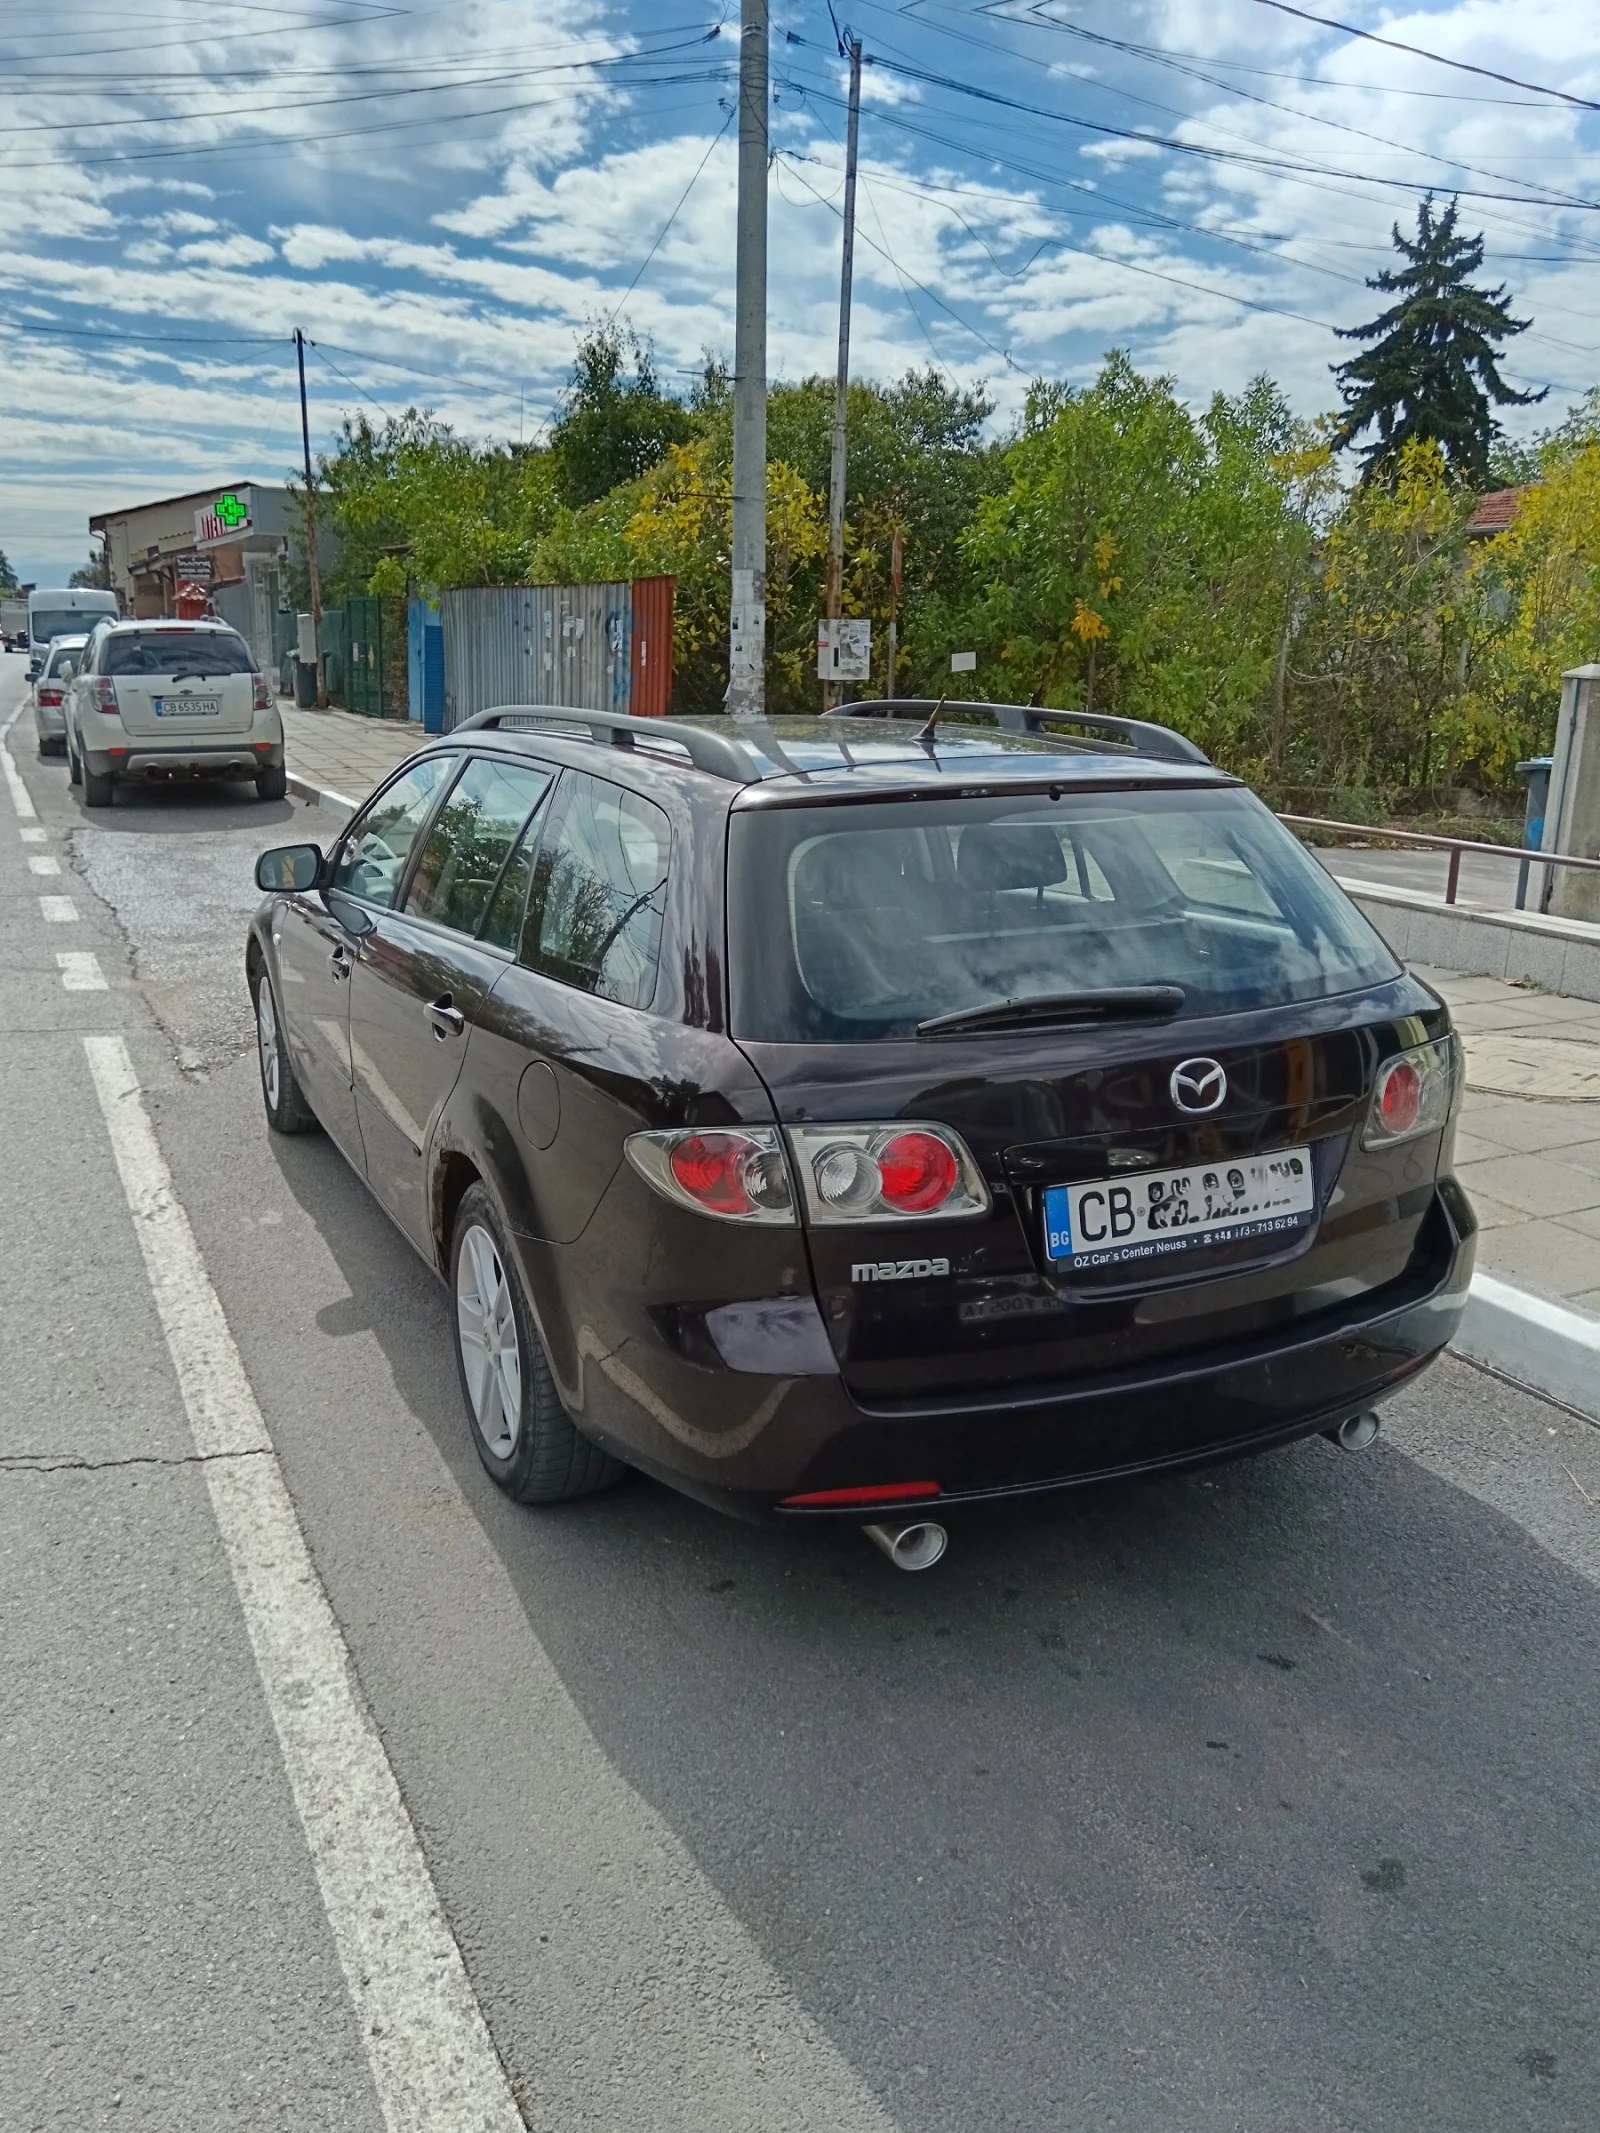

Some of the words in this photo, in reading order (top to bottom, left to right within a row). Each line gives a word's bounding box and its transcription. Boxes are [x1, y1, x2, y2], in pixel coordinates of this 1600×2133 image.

[163, 702, 176, 712] CB
[178, 701, 202, 712] 6535
[203, 702, 215, 711] HA
[1079, 1187, 1135, 1242] CB
[1050, 1230, 1070, 1248] BG
[1074, 1256, 1090, 1268] ÖZ
[1122, 1245, 1155, 1259] Center
[1157, 1239, 1187, 1253] Neuss
[1257, 1220, 1274, 1233] 713
[1275, 1218, 1286, 1230] 62
[1287, 1215, 1299, 1228] 94
